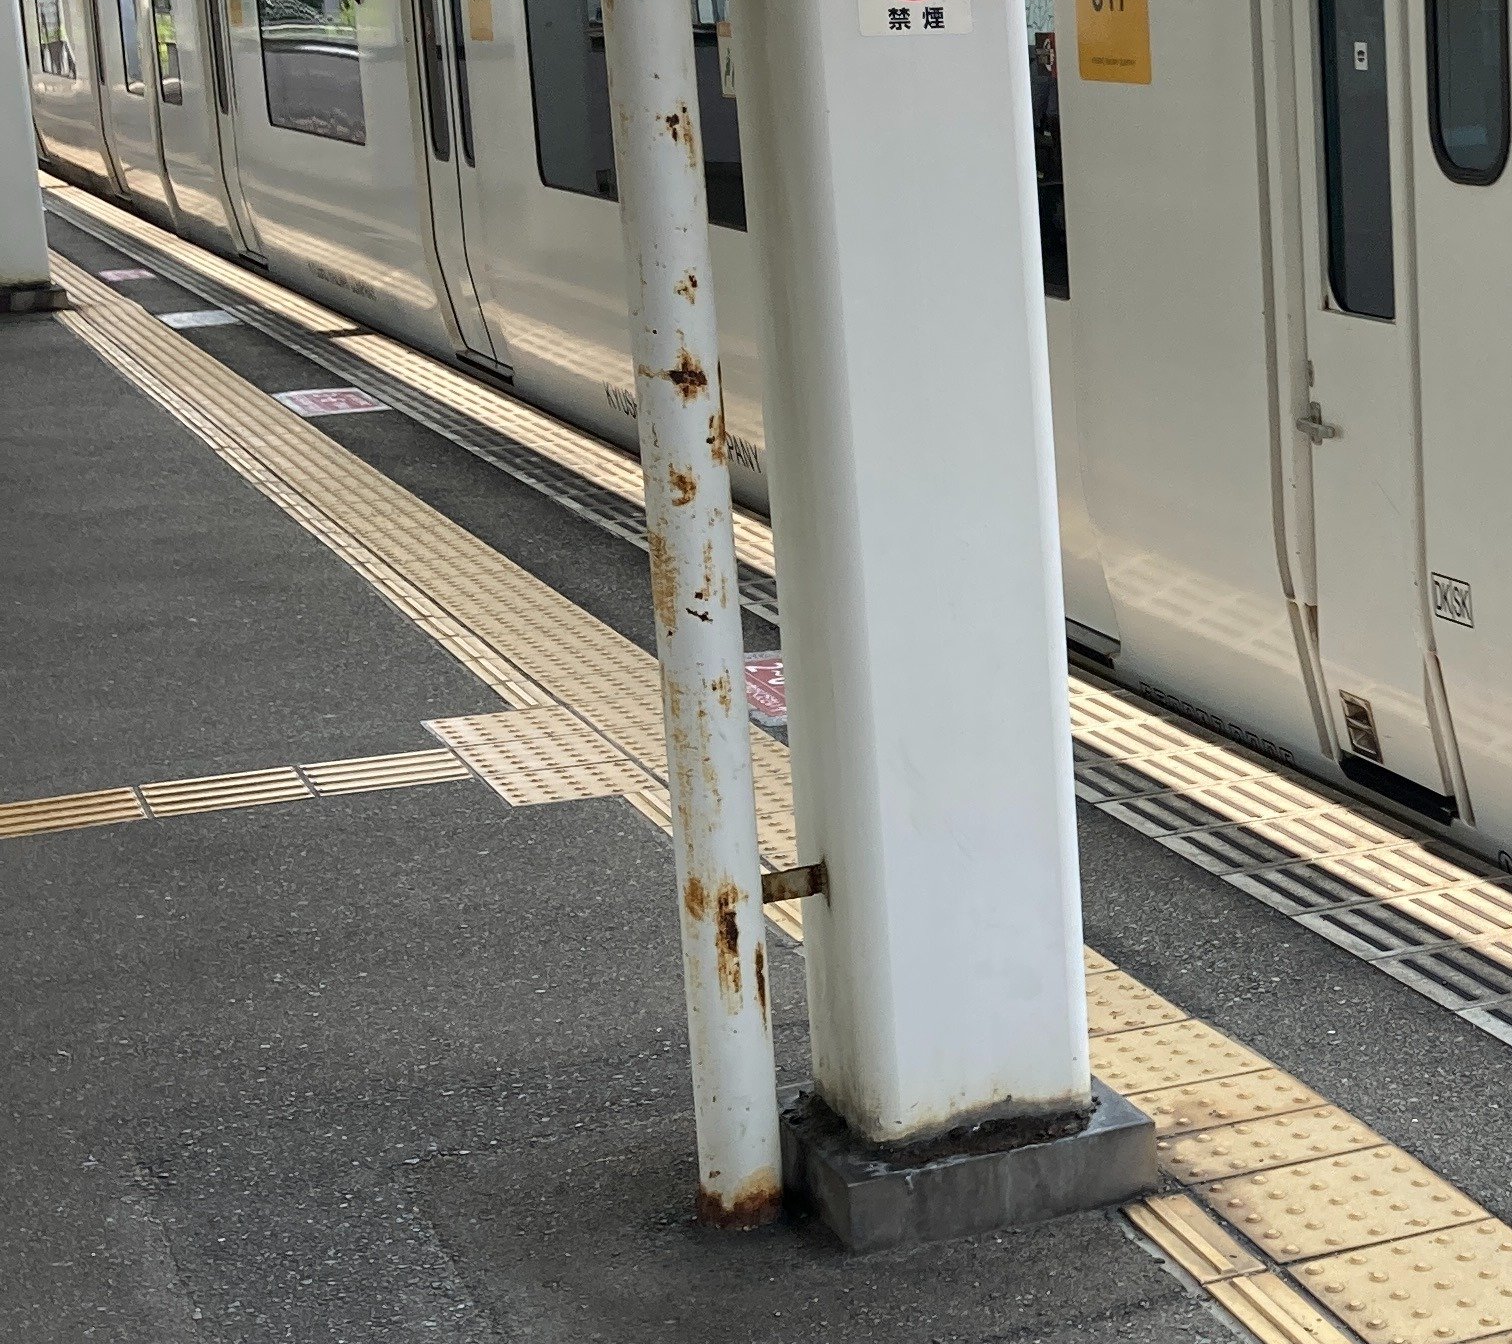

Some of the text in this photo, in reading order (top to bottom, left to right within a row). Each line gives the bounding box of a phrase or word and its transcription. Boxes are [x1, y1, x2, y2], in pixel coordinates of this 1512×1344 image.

[887, 6, 946, 31] 禁煙
[602, 380, 637, 419] KYUS
[725, 432, 761, 473] PANY
